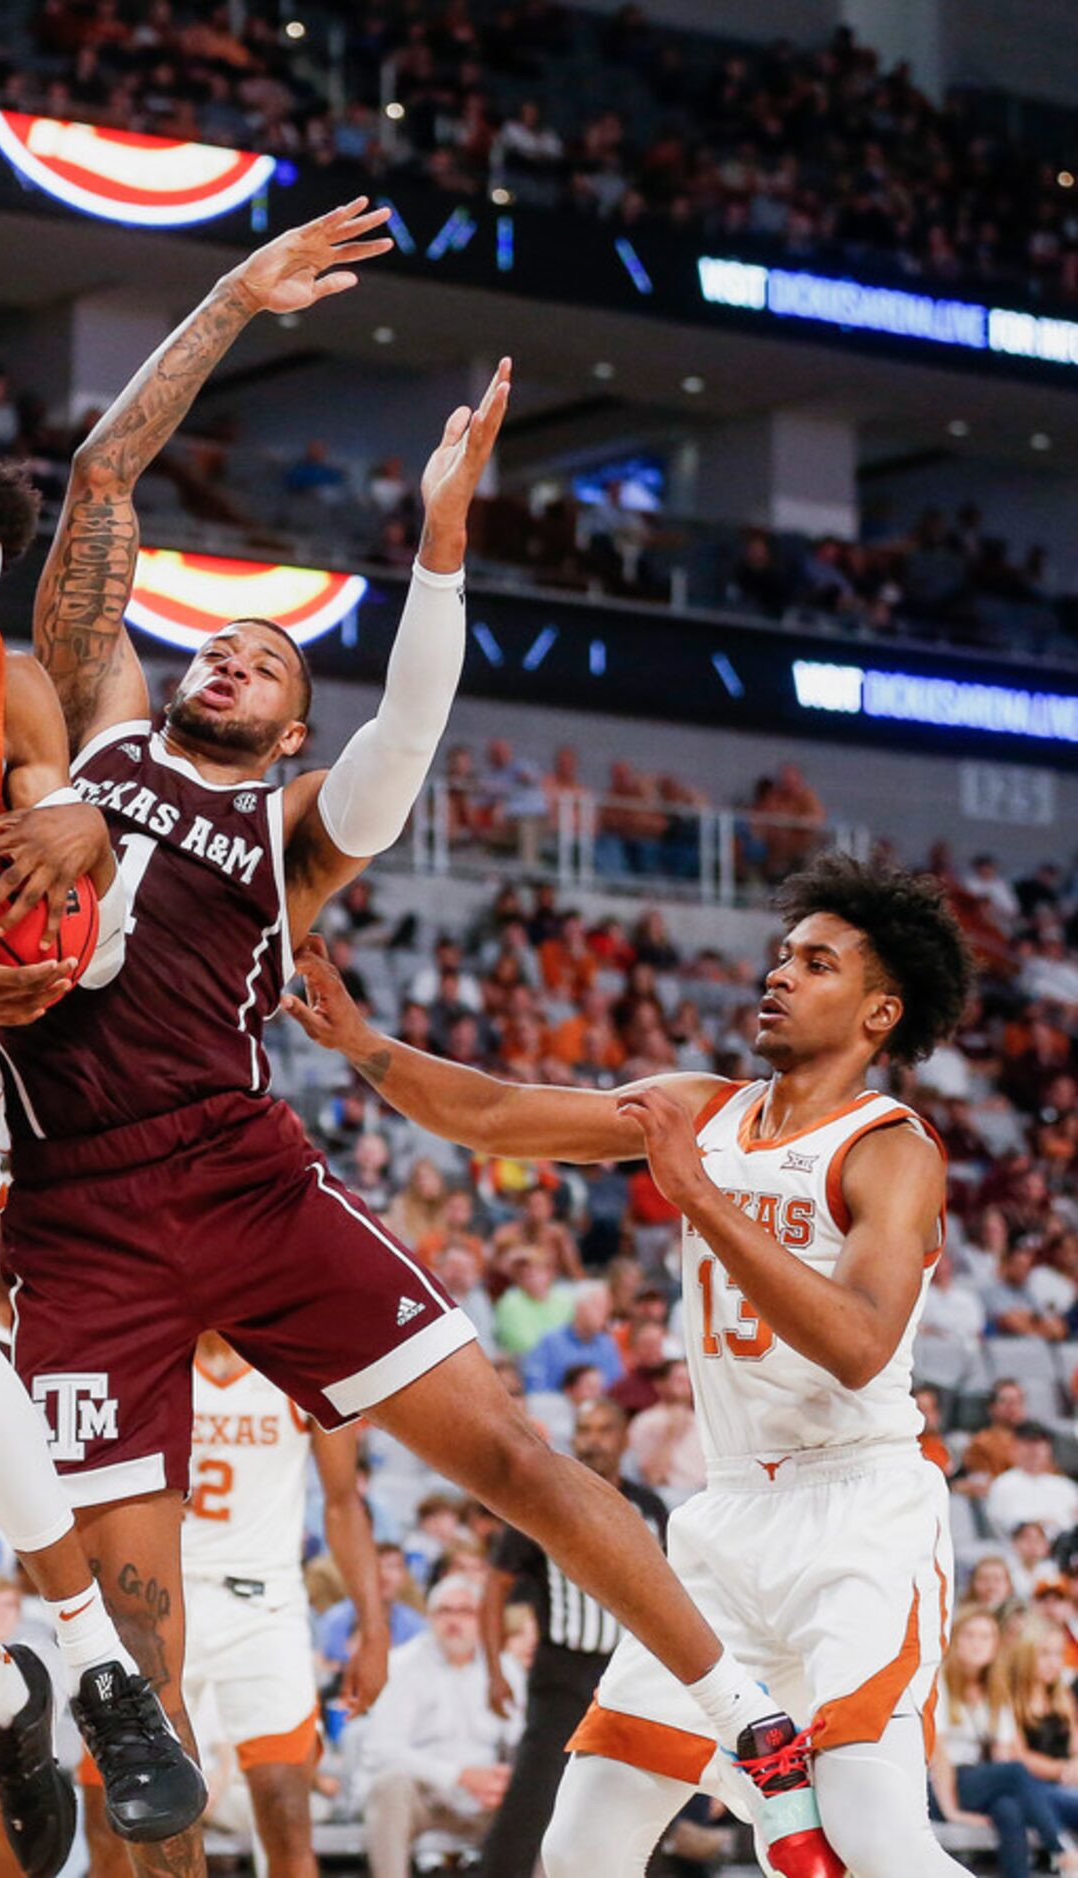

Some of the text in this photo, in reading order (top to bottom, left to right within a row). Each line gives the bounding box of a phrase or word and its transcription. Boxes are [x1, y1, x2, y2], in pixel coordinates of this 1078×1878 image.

[72, 776, 264, 885] TEXAS A&M
[119, 832, 159, 934] 1
[192, 1414, 279, 1446] EXAS
[193, 1458, 233, 1522] 2
